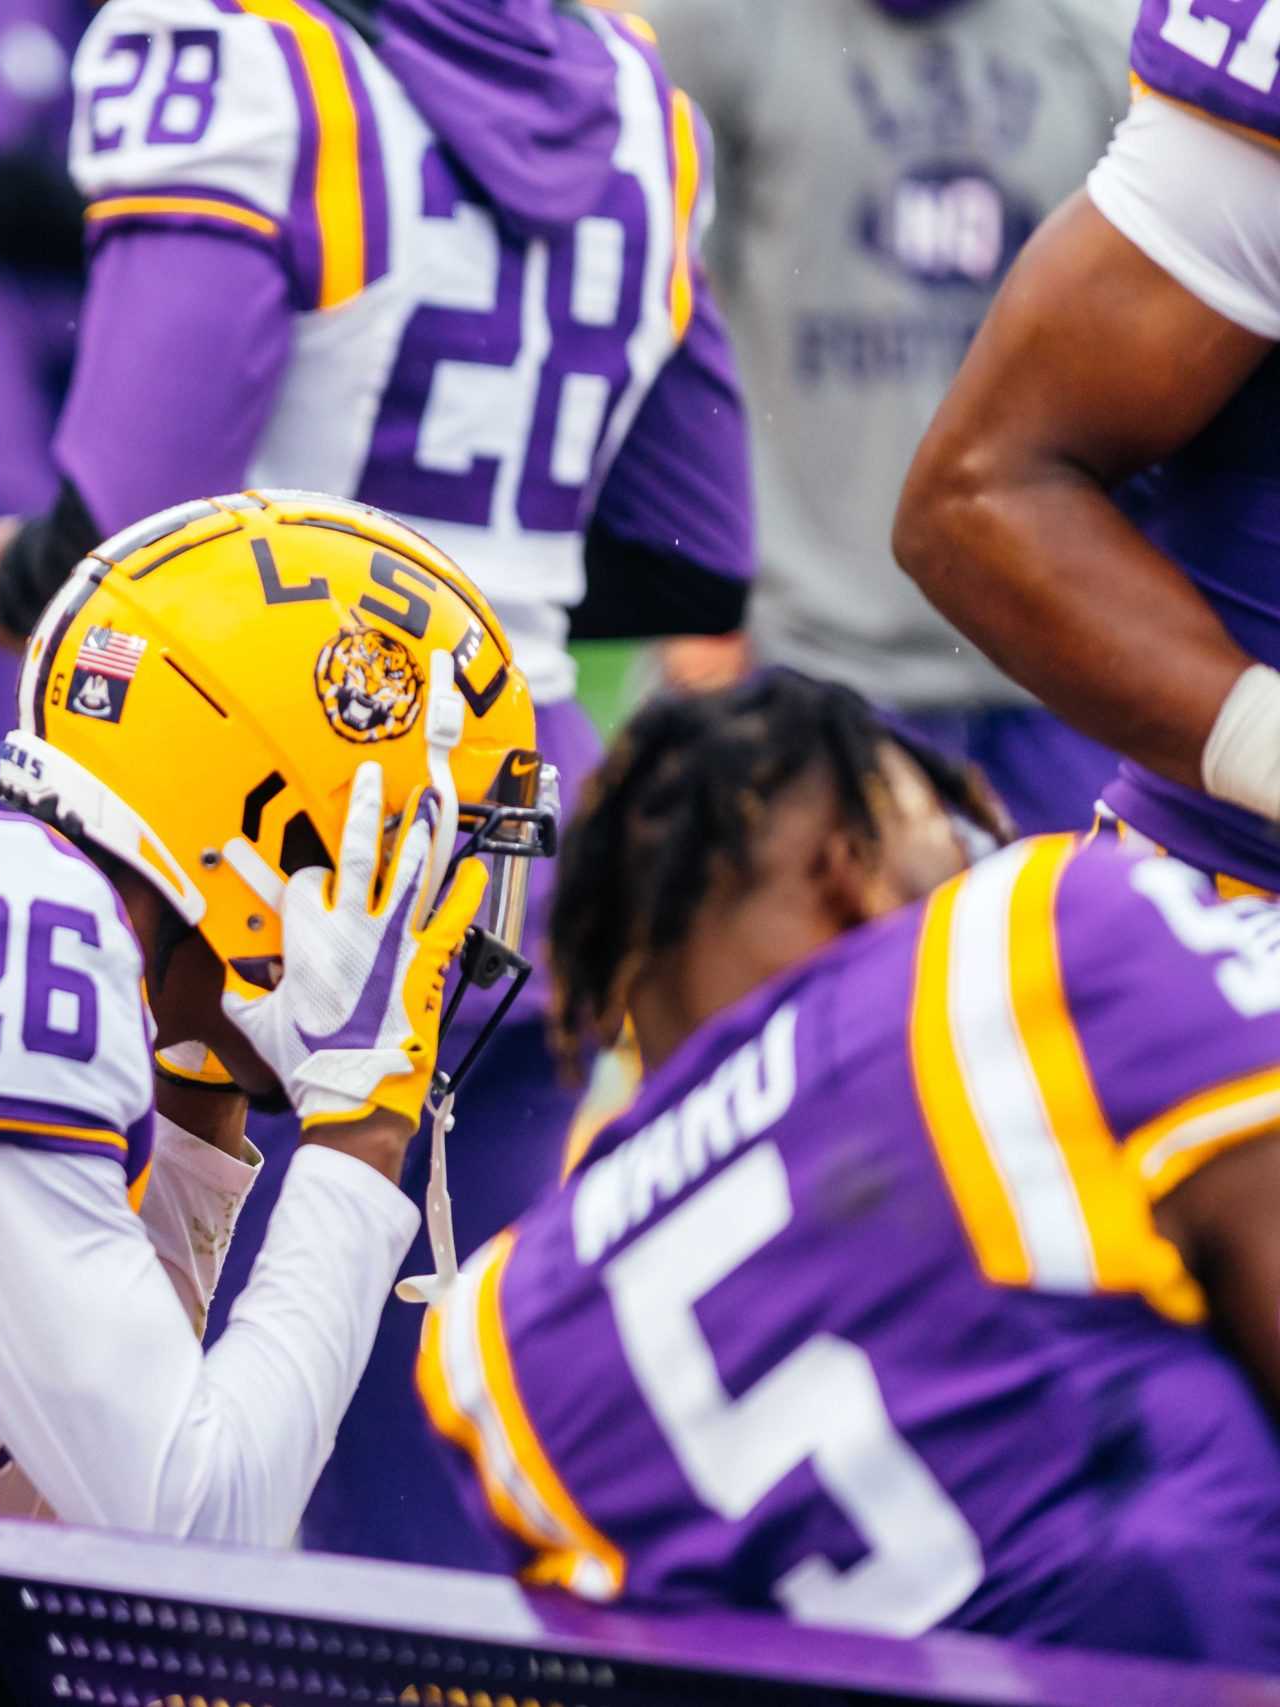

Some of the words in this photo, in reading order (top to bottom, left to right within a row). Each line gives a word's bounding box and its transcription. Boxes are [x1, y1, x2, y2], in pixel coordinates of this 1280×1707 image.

[87, 28, 221, 153] 28
[353, 140, 647, 533] 28
[250, 536, 510, 718] LSU
[604, 1138, 986, 1639] 5
